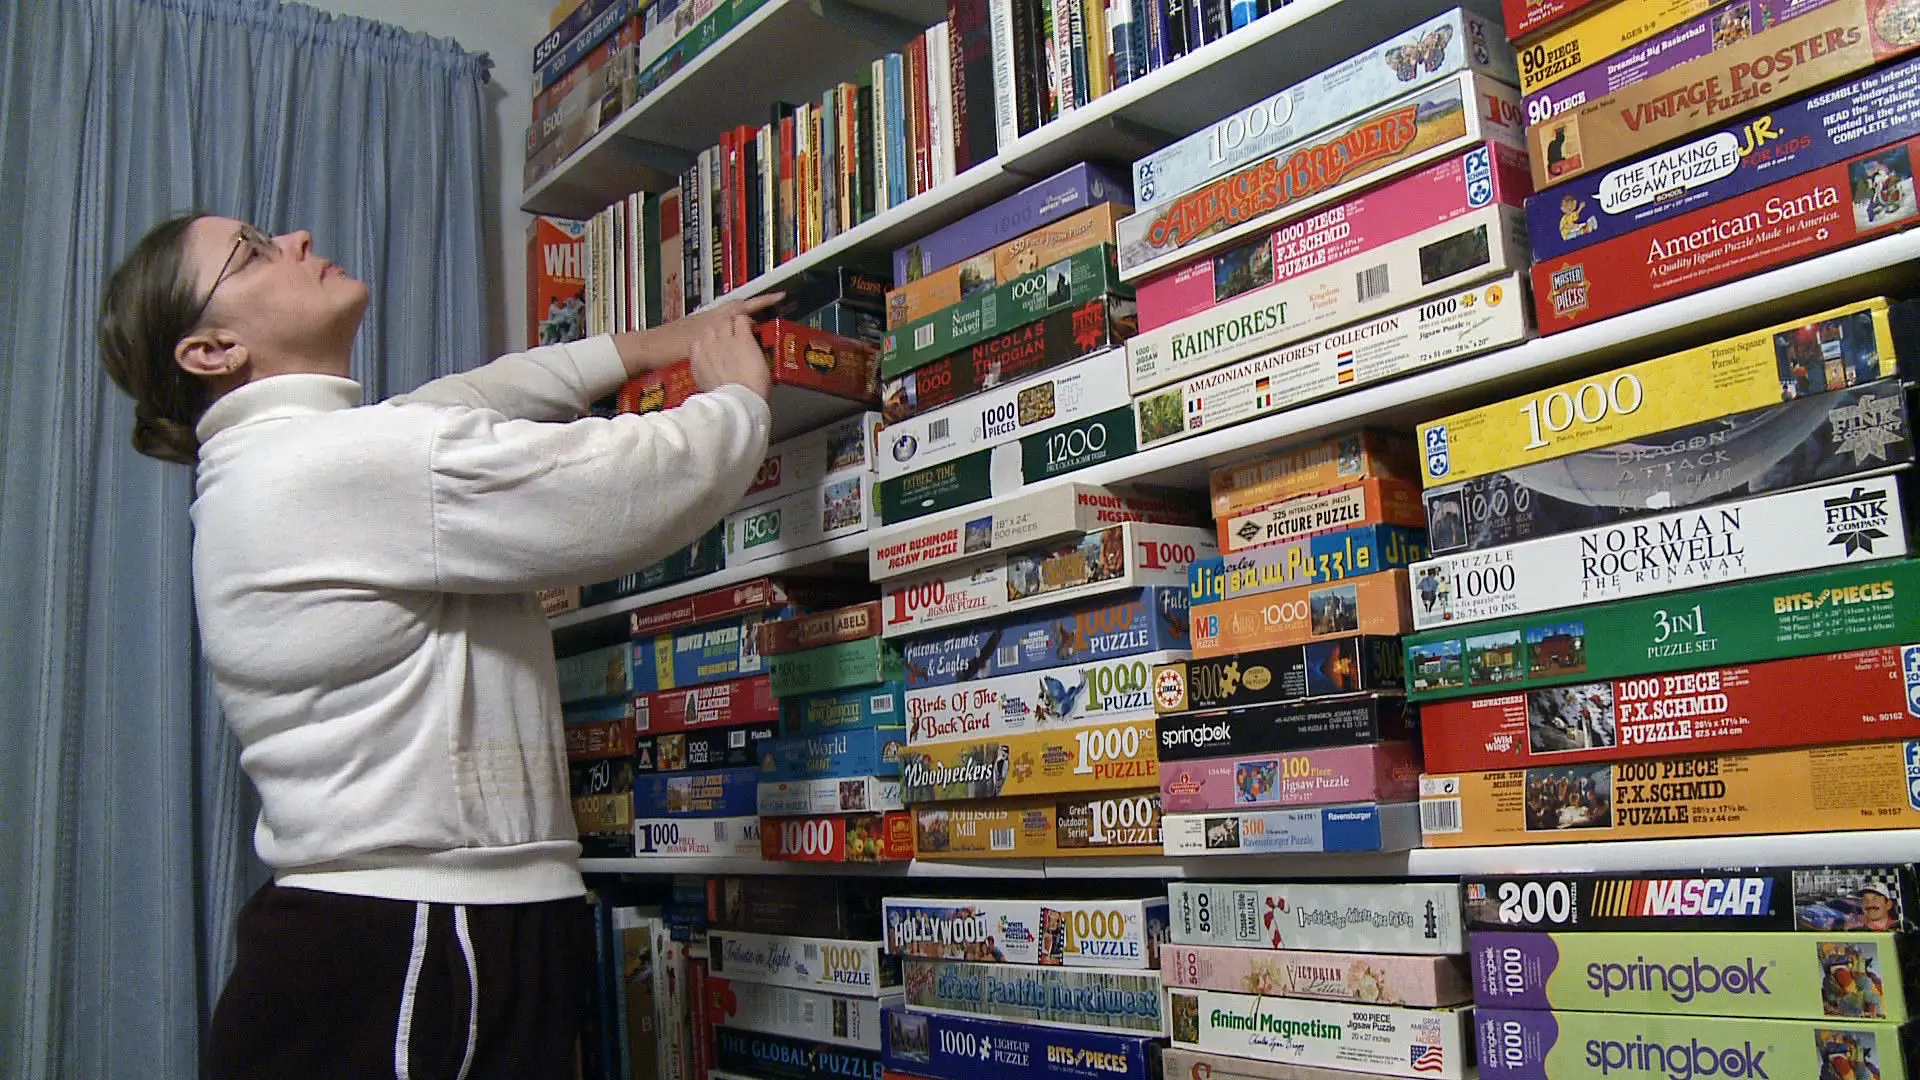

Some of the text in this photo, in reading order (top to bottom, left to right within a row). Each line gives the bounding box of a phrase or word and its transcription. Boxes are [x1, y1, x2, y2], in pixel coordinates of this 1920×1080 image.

[536, 31, 560, 65] 550
[1607, 24, 1705, 74] Dreaming Basketball
[1621, 27, 1642, 41] AGES
[1522, 40, 1579, 74] 90 PIECE
[1525, 52, 1581, 88] PUZZLE
[998, 63, 1009, 89] MIND
[1620, 75, 1723, 131] VINTAGE
[1729, 26, 1861, 93] POSTERS
[1528, 91, 1586, 126] 90 PIECE
[1706, 81, 1772, 116] Puzzle
[1807, 79, 1878, 110] ASSEMBLE the
[1852, 85, 1895, 104] windows
[1208, 93, 1293, 168] 1000
[1823, 105, 1868, 126] READ the
[1827, 108, 1893, 137] printed the
[1833, 114, 1907, 145] COMPLETE the
[1738, 115, 1784, 157] JR.
[1614, 141, 1718, 188] THE TALKING
[1743, 135, 1811, 169] FOR KIDS
[1606, 175, 1666, 209] JIGSAW
[1672, 149, 1736, 185] PUZZLE!
[1276, 206, 1345, 244] 1000 PIECE
[1646, 212, 1763, 265] American
[1765, 186, 1839, 225] Santa
[1277, 222, 1350, 263] F.X.SCHMID
[1658, 223, 1795, 277] Quality Jigsaw Puzzle Made in
[1277, 250, 1326, 281] PUZZLE
[1552, 263, 1581, 290] MASTER
[1012, 274, 1046, 300] 1000
[952, 309, 980, 324] Norman
[1419, 298, 1457, 321] 1000
[973, 321, 1044, 361] NICOLAS
[1172, 302, 1287, 362] RAINFOREST
[1188, 365, 1252, 394] AMAZONIAN
[1254, 343, 1320, 373] RAINFOREST
[1325, 317, 1399, 350] COLLECTION
[1710, 338, 1767, 359] Times Square
[1712, 356, 1740, 369] Parade
[982, 402, 1015, 440] 1000
[1519, 372, 1642, 451] 1000
[988, 420, 1016, 438] PIECES
[1045, 423, 1106, 466] 1200
[1078, 493, 1122, 509] MOUNT
[1272, 495, 1351, 520] 325 INTERLOCKING PIECES
[1825, 499, 1889, 527] FINK
[1266, 503, 1360, 538] PICTURE PUZZLE
[1580, 507, 1741, 557] NORMAN
[1837, 517, 1889, 533] COMPANY
[877, 529, 958, 560] MOUNT RUSHMORE
[888, 542, 958, 569] JIGSAW PUZZLE
[1138, 541, 1195, 570] 1000
[1288, 536, 1371, 582] Puzzle
[1451, 550, 1513, 570] PUZZLE
[1582, 532, 1745, 579] ROCKWELL
[1191, 559, 1285, 600] Jigsaw
[1454, 564, 1515, 599] 1000
[1582, 554, 1745, 591] THE RUNAWAY
[888, 578, 946, 625] 1000
[927, 596, 987, 618] JIGSAW PUZZLE
[945, 590, 968, 602] PIECE
[1773, 580, 1895, 614] BITS PIECES
[1196, 614, 1219, 639] MB
[1261, 600, 1308, 625] 1000
[1090, 630, 1149, 653] PUZZLE
[1647, 639, 1717, 660] PUZZLE SET
[937, 655, 969, 677] Eagles
[1084, 661, 1146, 713] 1000
[1619, 680, 1661, 701] 1000
[1664, 670, 1720, 695] PIECE
[907, 688, 998, 720] Birds Of The
[1620, 694, 1728, 723] F.X.SCHMID
[922, 713, 990, 738] Back Yard
[1162, 722, 1231, 749] springbok
[1621, 720, 1691, 745] PUZZLE
[808, 736, 846, 756] World
[1074, 726, 1139, 776] 1000
[589, 760, 610, 793] 750
[904, 758, 994, 790] Woodpeckers
[1094, 760, 1157, 780] PUZZLE
[1282, 756, 1310, 777] 100
[1617, 757, 1719, 782] 1000 PIECE
[1282, 776, 1350, 793] Jigsaw Puzzle
[1616, 779, 1726, 804] F.X.SCHMID
[1058, 817, 1088, 828] Outdoors
[1070, 805, 1088, 816] Great
[1089, 798, 1153, 843] 1000
[1328, 811, 1371, 820] Ravensburger
[1617, 804, 1689, 826] PUZZLE
[639, 823, 678, 853] 1000
[780, 820, 833, 855] 1000
[957, 823, 976, 837] Mill
[1068, 828, 1088, 838] Series
[1243, 819, 1264, 835] 500
[1499, 880, 1571, 924] 200
[1643, 878, 1765, 916] NASCAR
[1199, 893, 1210, 933] 500
[1248, 897, 1257, 935] FAMILIAL
[895, 914, 987, 946] HOLLYWOOD
[1063, 910, 1124, 952] 1000
[820, 944, 861, 980] 1000
[1080, 940, 1139, 957] PUZZLE
[834, 970, 871, 985] PUZZLE
[1286, 964, 1341, 990] VICTORIAN
[1485, 946, 1497, 995] springbok
[1503, 948, 1524, 996] 1000
[1586, 956, 1772, 1002] springbok
[1211, 1009, 1342, 1041] Animal Magnetism
[1347, 1020, 1396, 1032] Jigsaw Puzzle
[1369, 1013, 1391, 1023] PIECE
[751, 1040, 808, 1065] GLOBAL
[939, 1029, 977, 1058] 1000
[994, 1051, 1030, 1066] PUZZLE
[1047, 1045, 1074, 1063] BITS
[1086, 1052, 1128, 1073] PIECES
[1485, 1019, 1497, 1068] springbok
[1503, 1021, 1524, 1070] 1000
[1585, 1033, 1771, 1080] springbok
